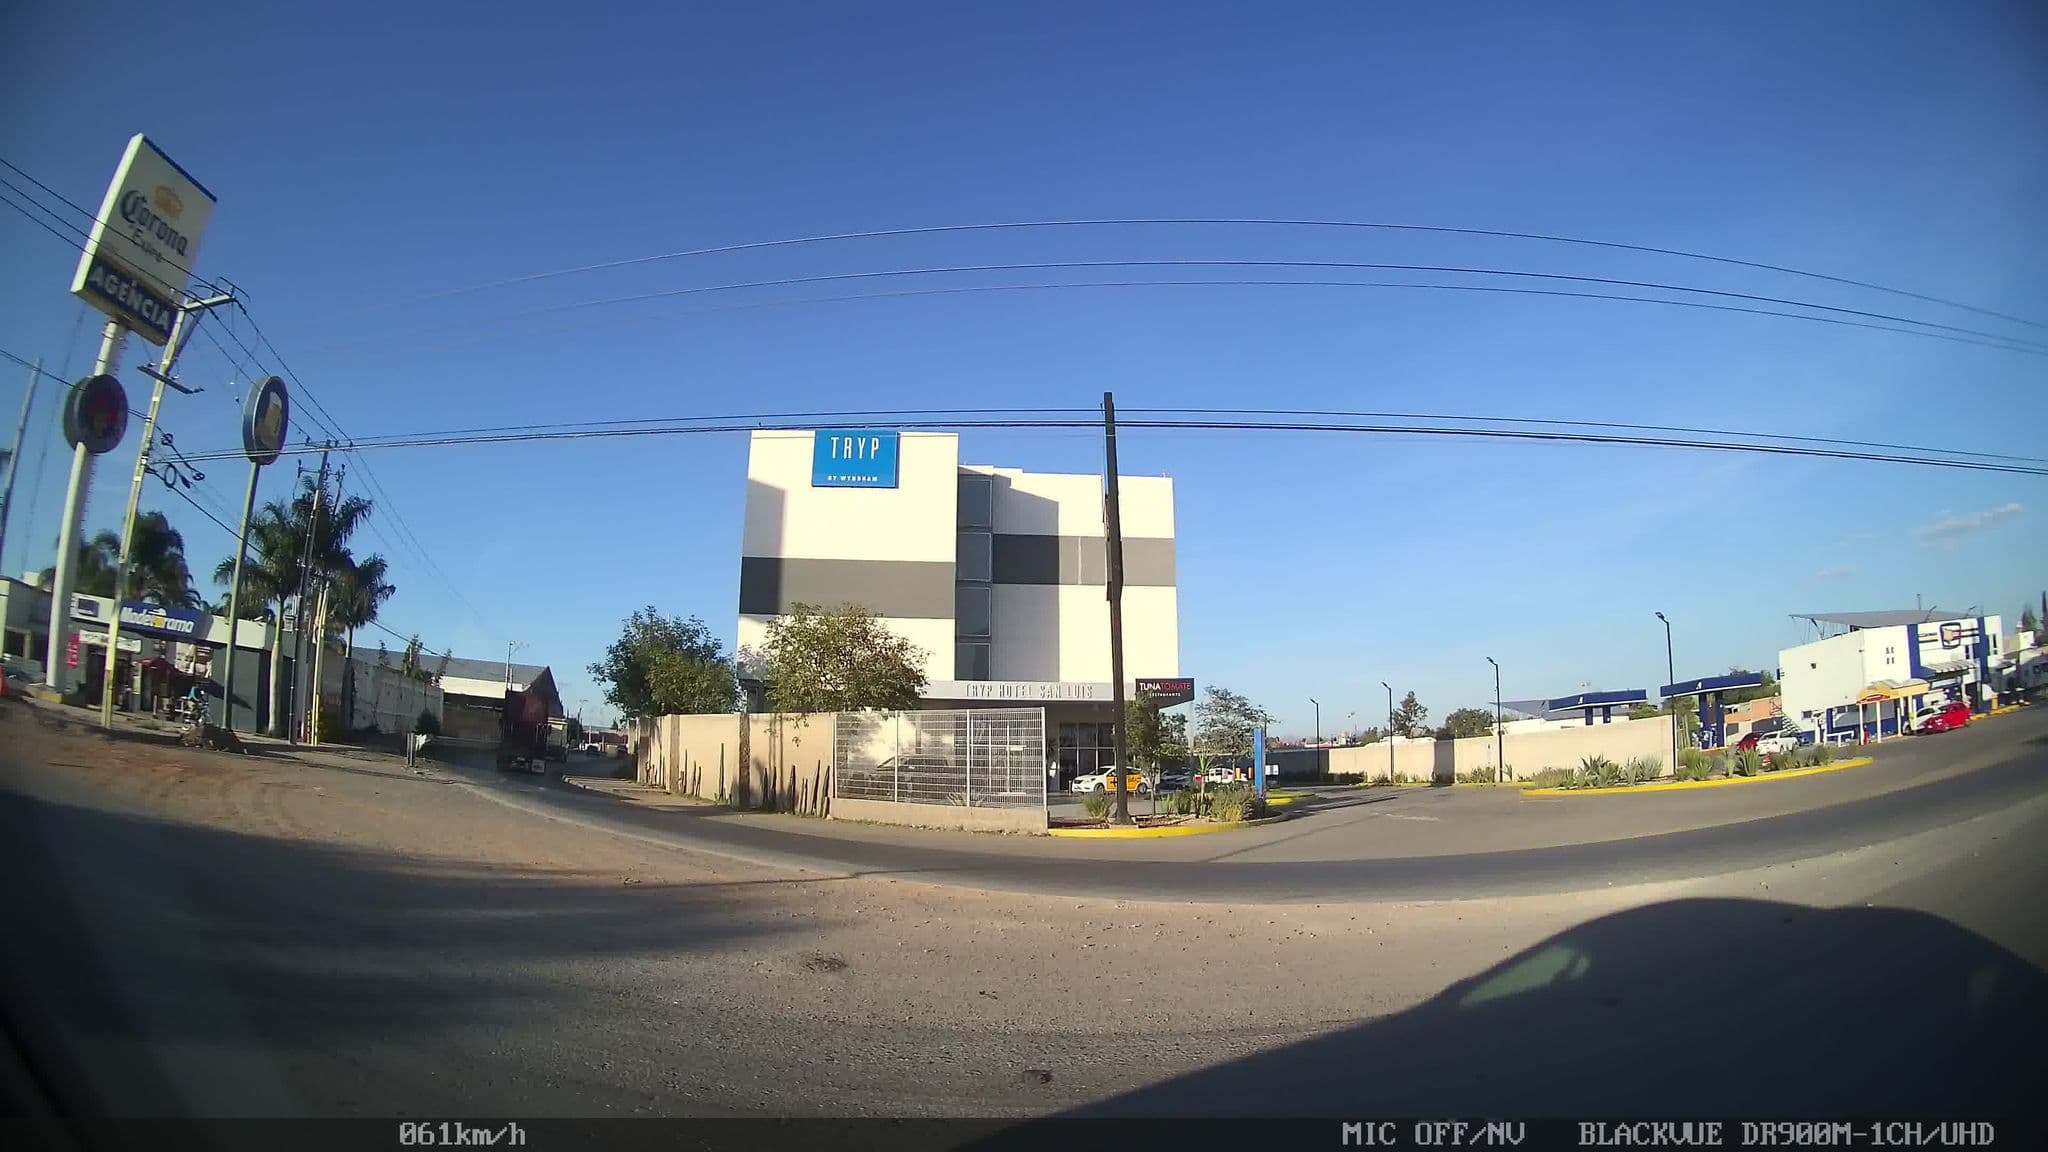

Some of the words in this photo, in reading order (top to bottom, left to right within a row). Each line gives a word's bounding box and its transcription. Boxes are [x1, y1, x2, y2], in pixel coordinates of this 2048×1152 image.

[120, 189, 188, 257] Corona
[831, 437, 879, 459] TRYP
[966, 684, 993, 697] TRYP
[999, 684, 1033, 698] HOTEL
[1040, 684, 1061, 699] SAN
[1067, 684, 1093, 699] LUIS
